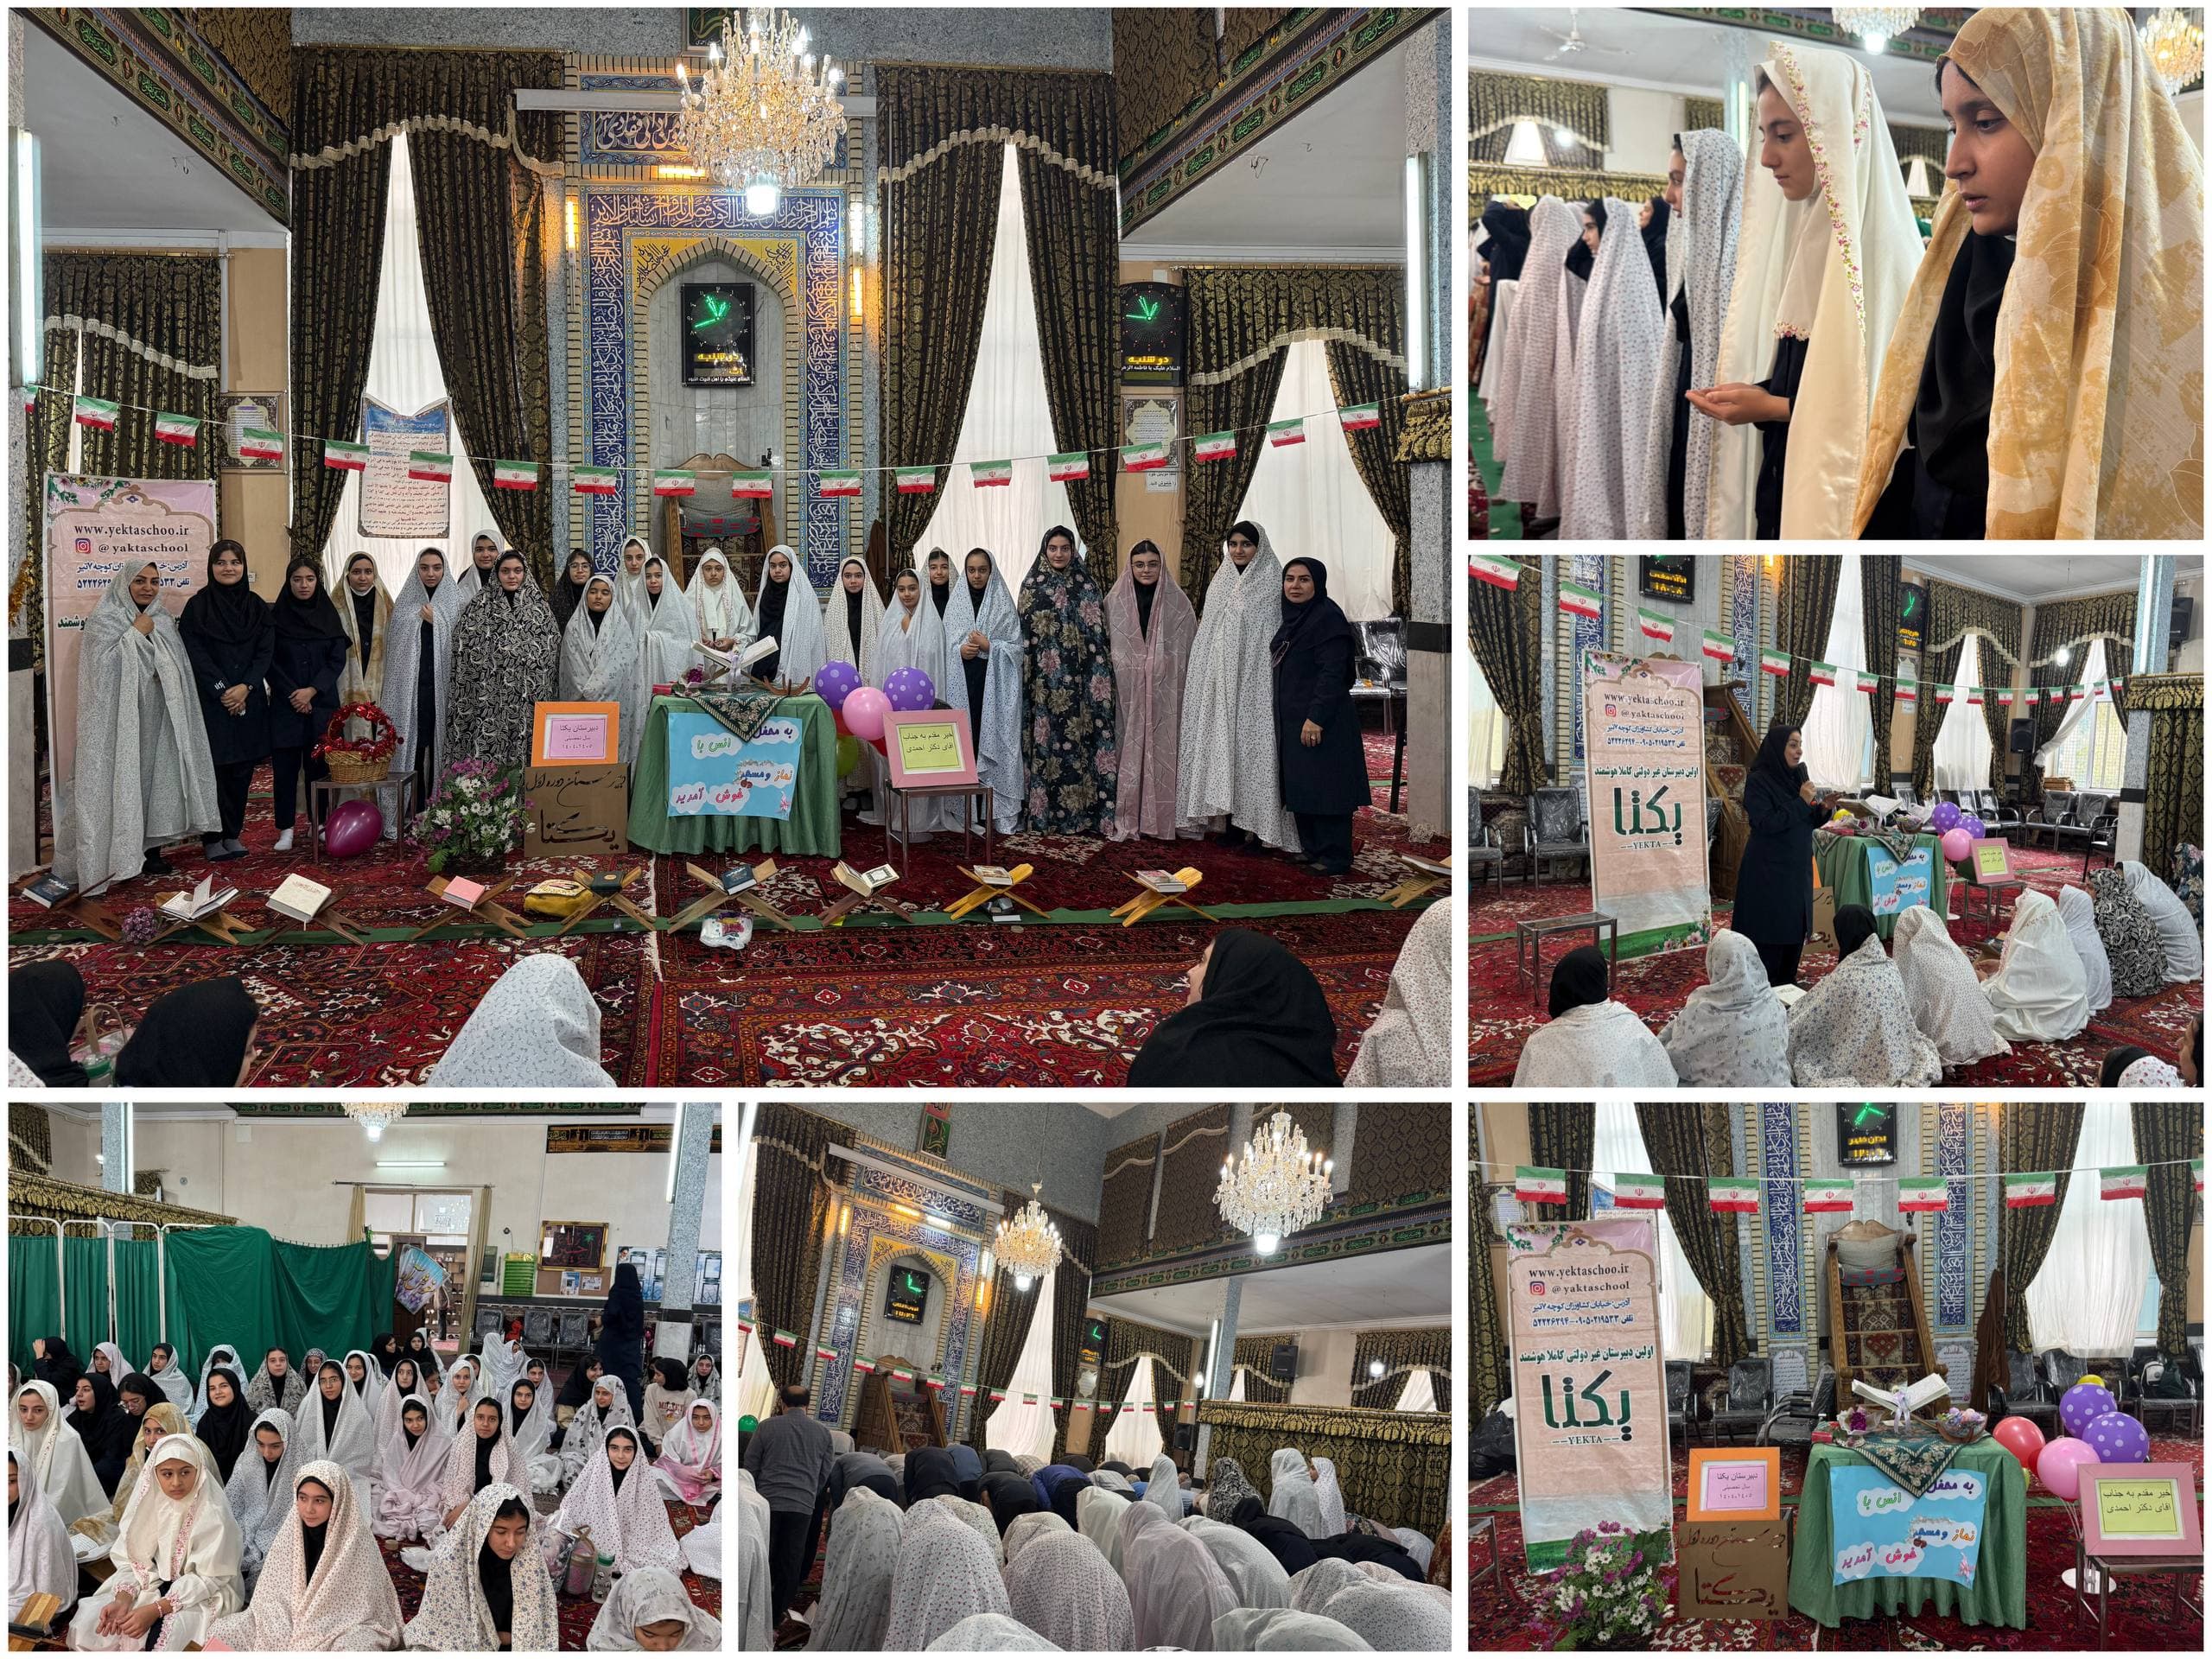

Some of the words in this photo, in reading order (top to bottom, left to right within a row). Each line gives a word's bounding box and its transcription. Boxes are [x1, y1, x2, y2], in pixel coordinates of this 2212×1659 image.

[74, 523, 189, 538] www.yektaschoo.ir
[93, 563, 113, 573] کوچه
[176, 576, 190, 588] تلفن
[57, 614, 85, 630] وشمند
[784, 726, 793, 739] به
[676, 787, 704, 804] آمدید
[715, 788, 744, 804] خوش
[1613, 785, 1683, 846] یکتا
[540, 809, 620, 850] یکتا
[1633, 841, 1662, 849] YEKTA
[1529, 1263, 1630, 1280] www.yektaschoo.ir
[1547, 1302, 1564, 1312] کوچه
[1620, 1314, 1634, 1325] تلفن
[1519, 1351, 1547, 1364] هوشمند
[1547, 1349, 1565, 1363] کاملا
[1567, 1349, 1588, 1363] دولتی
[1590, 1348, 1601, 1362] غیر
[1603, 1348, 1634, 1361] دبیرستان
[1635, 1345, 1654, 1358] اولین
[1541, 1369, 1633, 1442] یکتا
[1568, 1435, 1604, 1445] YEKTA
[1962, 1481, 1974, 1495] به
[2102, 1489, 2124, 1499] جناب
[2137, 1488, 2153, 1499] مقدم
[2158, 1489, 2171, 1499] خیر
[1876, 1491, 1902, 1508] انس
[2107, 1503, 2132, 1514] احمدی
[1951, 1528, 1975, 1542] نماز
[1841, 1547, 1873, 1569] آمدید
[1885, 1547, 1917, 1564] خوش
[1694, 1567, 1779, 1616] یکتا
